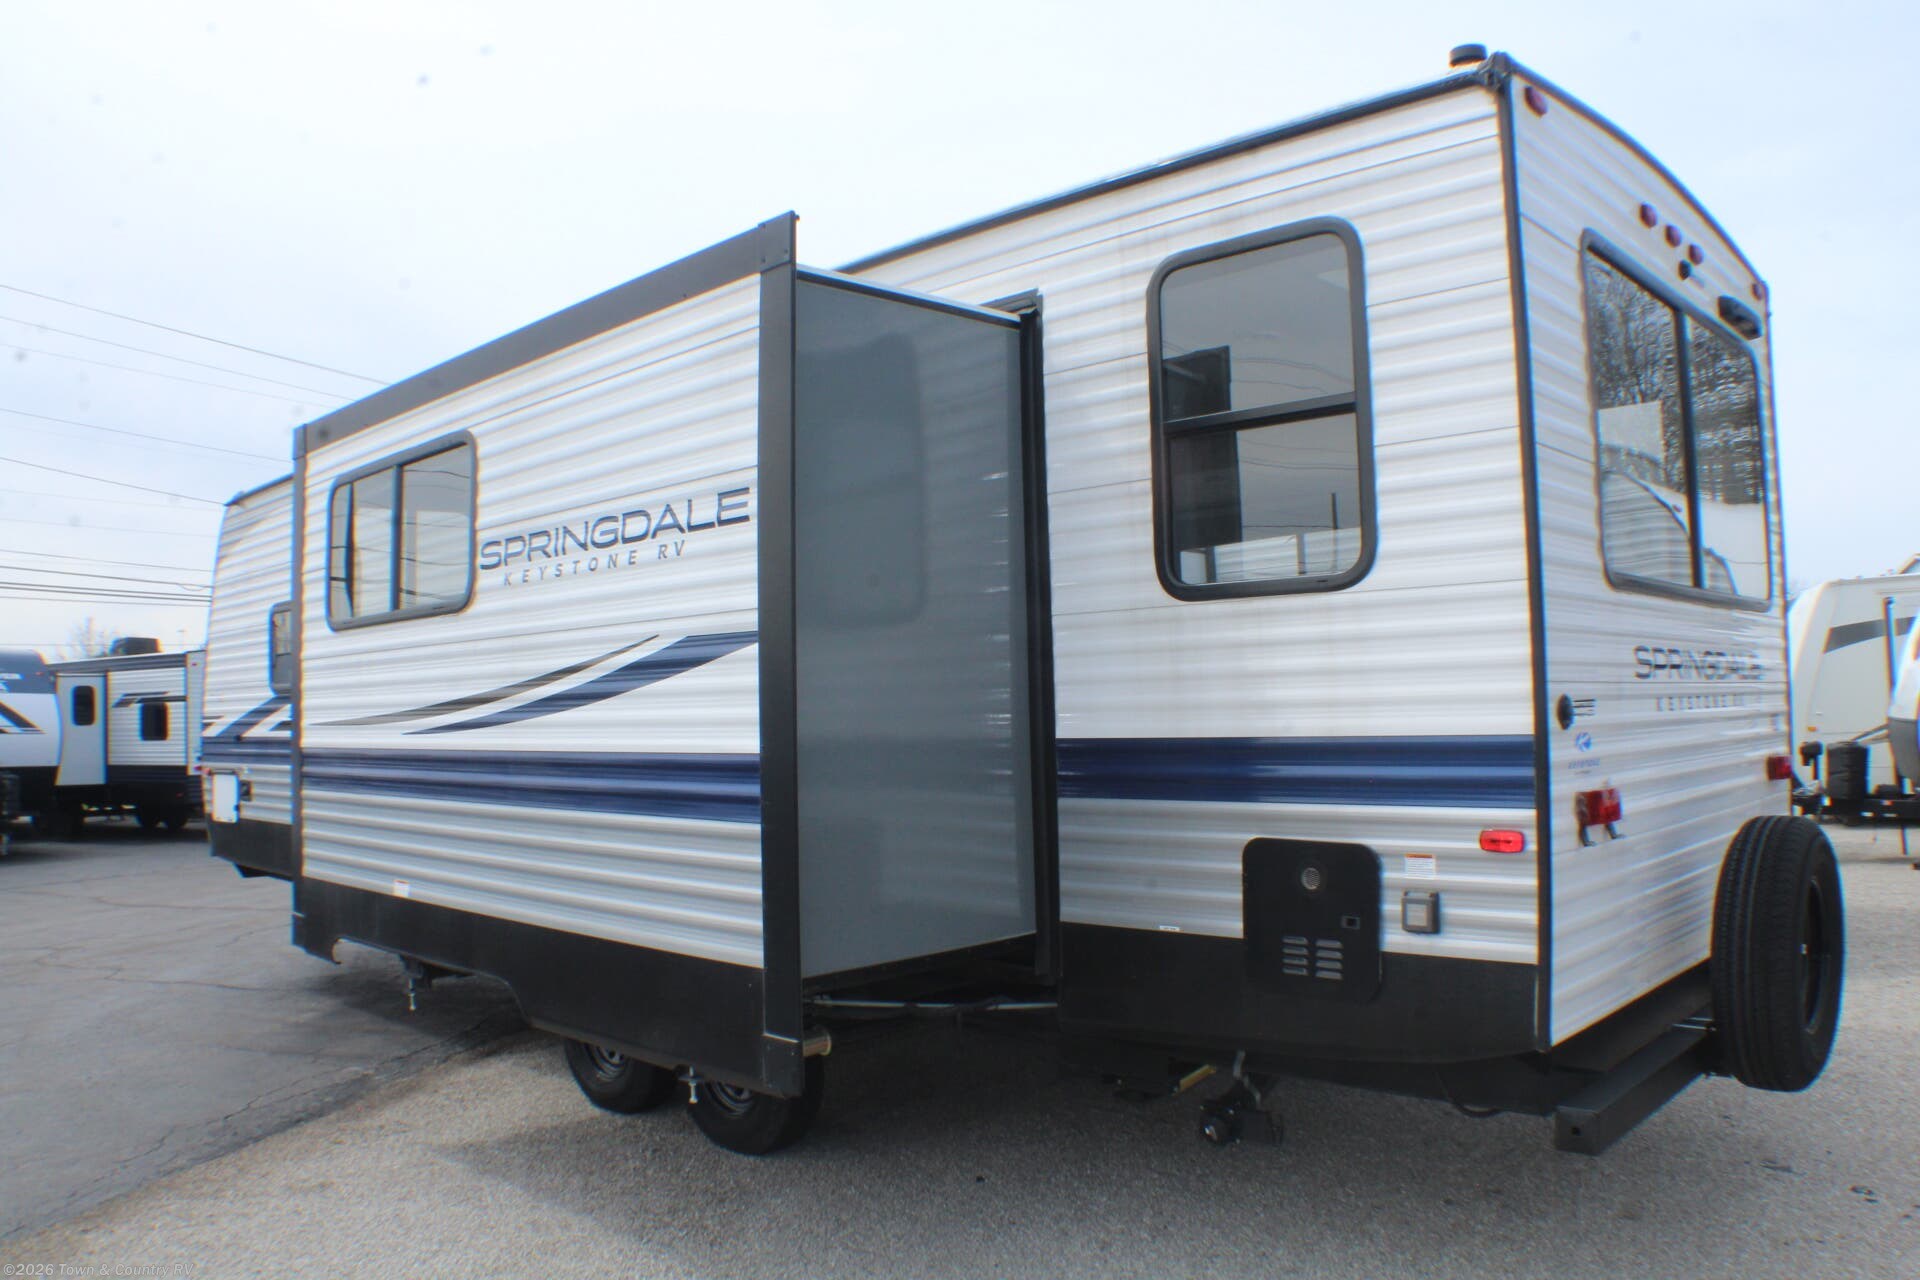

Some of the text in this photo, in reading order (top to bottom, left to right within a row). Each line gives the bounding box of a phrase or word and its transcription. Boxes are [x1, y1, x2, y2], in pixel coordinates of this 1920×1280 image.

[480, 487, 750, 570] SPRINGDALE
[503, 540, 686, 586] KEYSTONE RV
